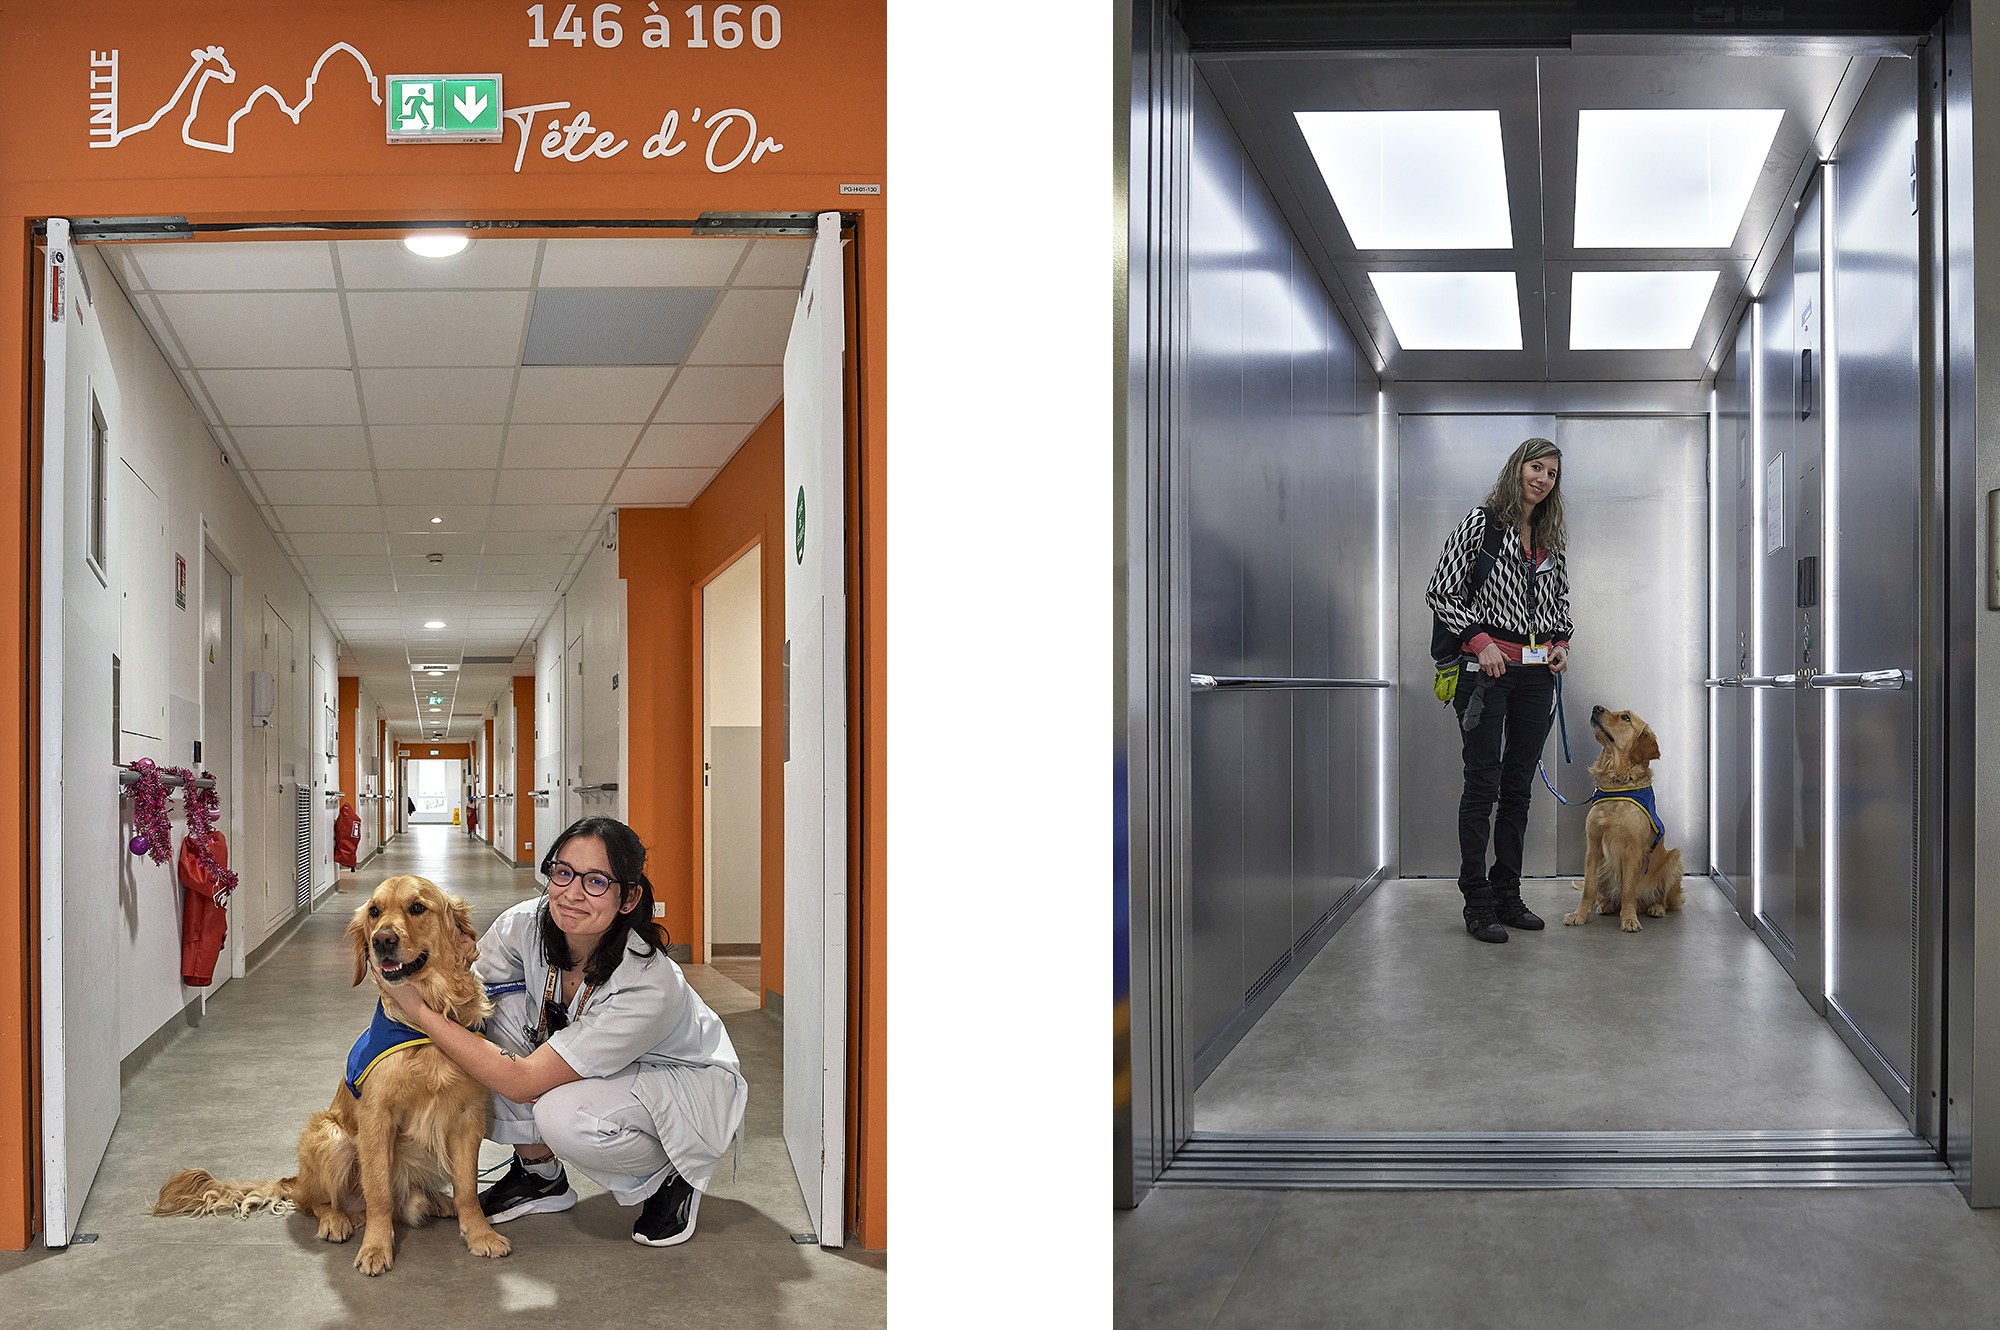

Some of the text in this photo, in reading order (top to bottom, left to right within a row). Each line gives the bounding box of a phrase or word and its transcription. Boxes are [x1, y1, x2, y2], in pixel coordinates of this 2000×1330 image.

[526, 1, 781, 49] 146 à 160
[89, 49, 118, 148] UNITE
[504, 101, 784, 173] Tête d'Or
